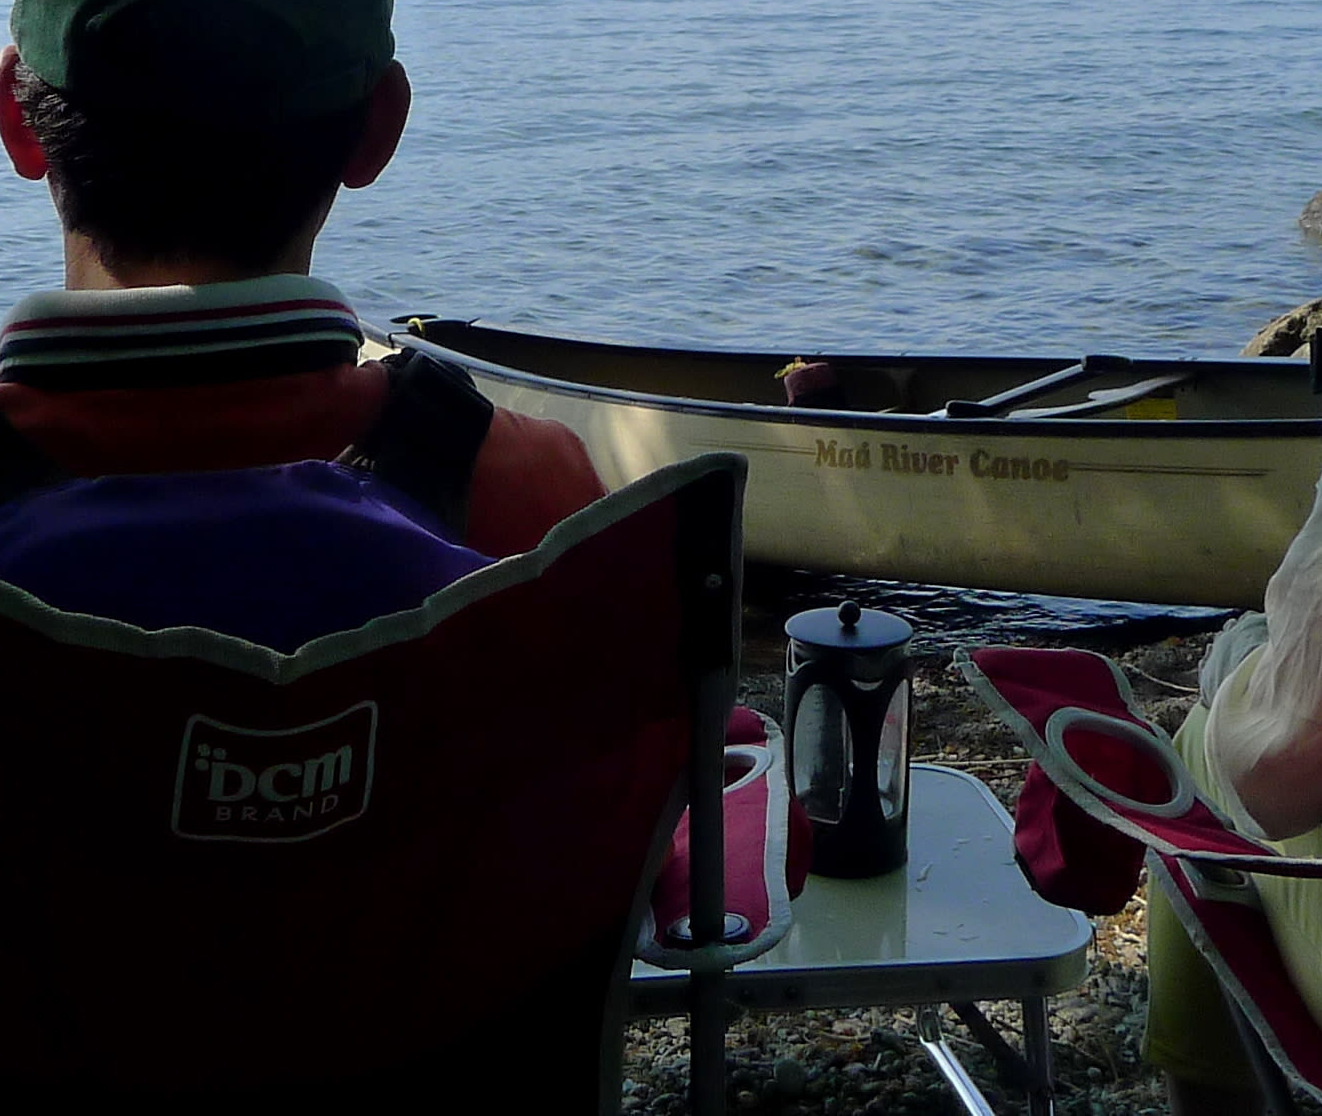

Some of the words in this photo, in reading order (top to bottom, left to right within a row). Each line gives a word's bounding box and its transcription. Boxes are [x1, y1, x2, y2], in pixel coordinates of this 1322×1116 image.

[814, 439, 871, 469] Mad
[880, 443, 960, 476] River
[969, 448, 1069, 482] Canoe
[215, 794, 339, 821] BRAND
